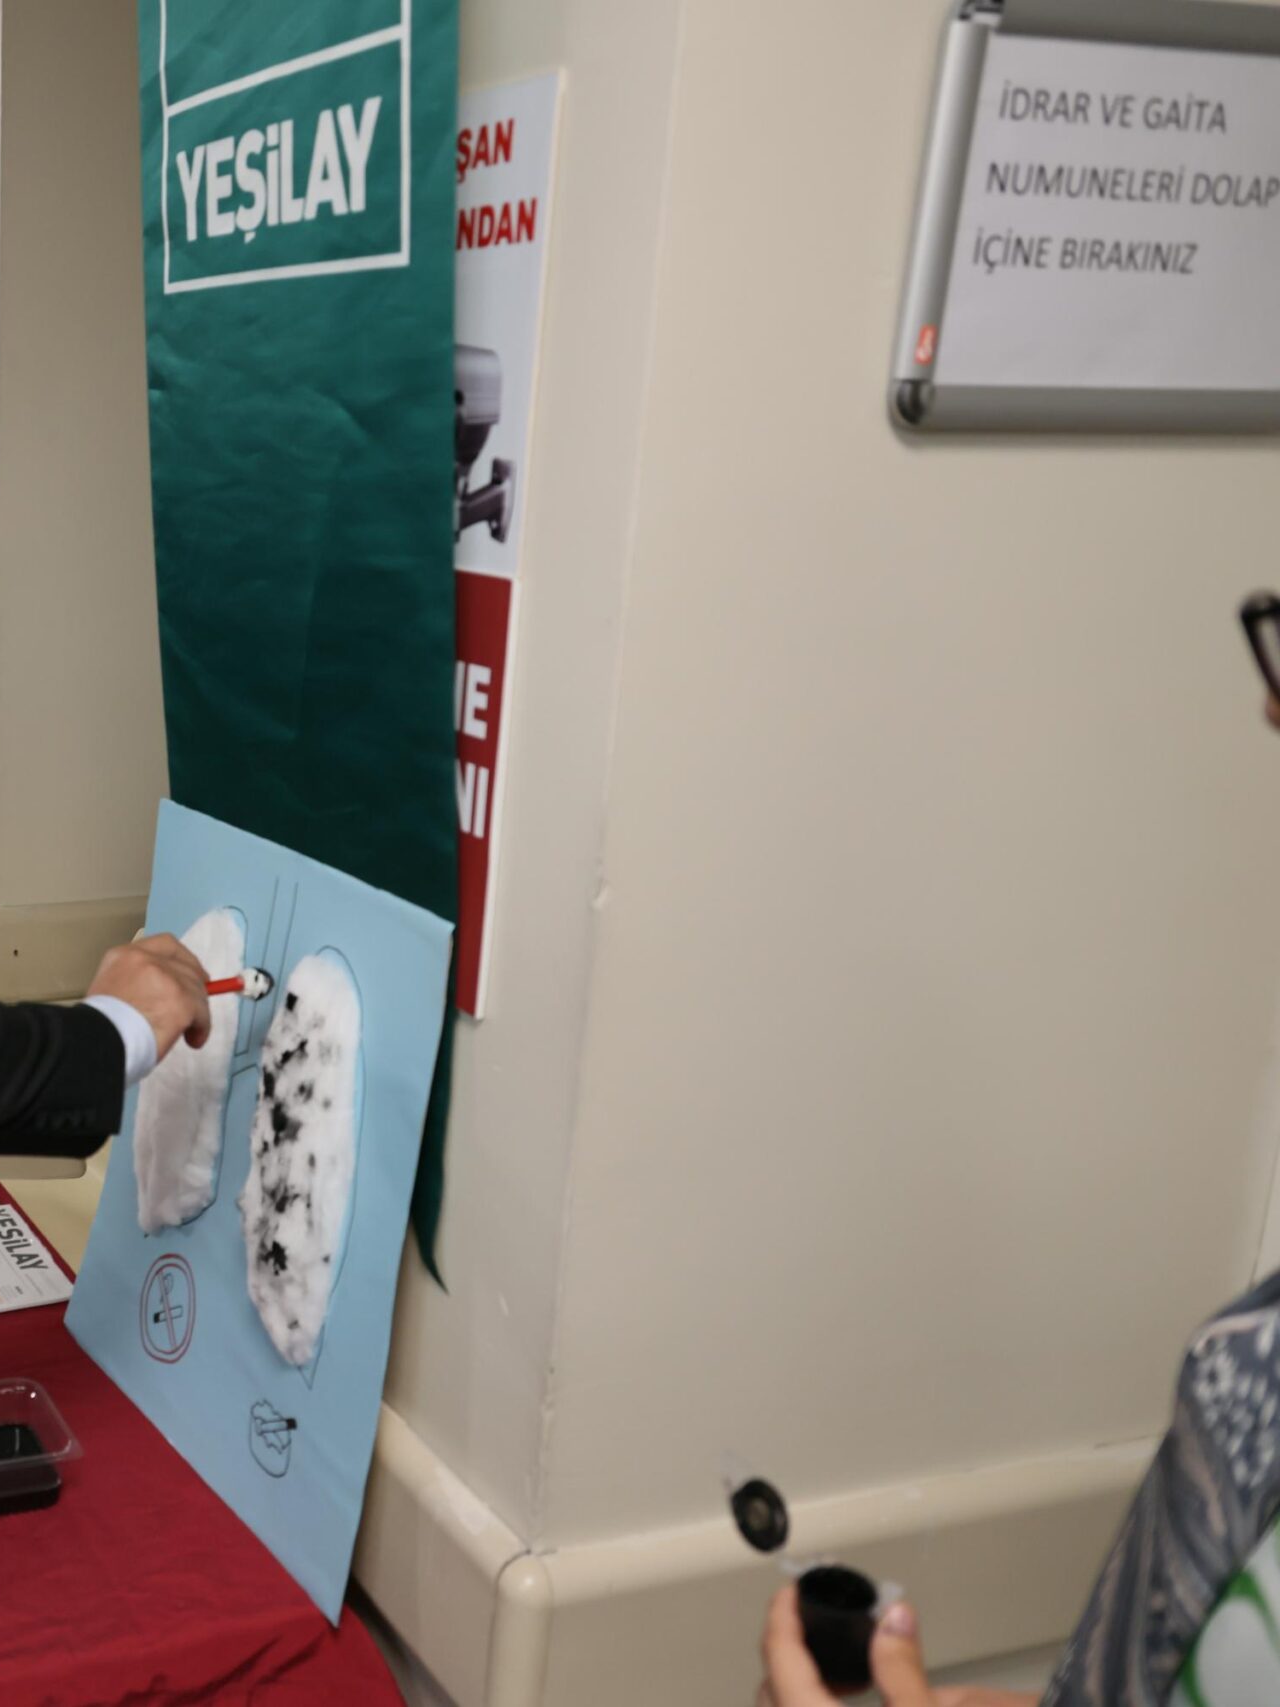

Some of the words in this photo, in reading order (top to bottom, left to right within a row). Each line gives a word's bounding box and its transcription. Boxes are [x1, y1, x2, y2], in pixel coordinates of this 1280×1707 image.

[999, 79, 1091, 123] İDRAR
[1101, 93, 1135, 128] VE
[1143, 92, 1227, 134] GAİTA
[986, 162, 1185, 203] NUMUNELERİ
[973, 227, 1053, 274] İÇİNE
[1059, 237, 1198, 275] BIRAKINIZ
